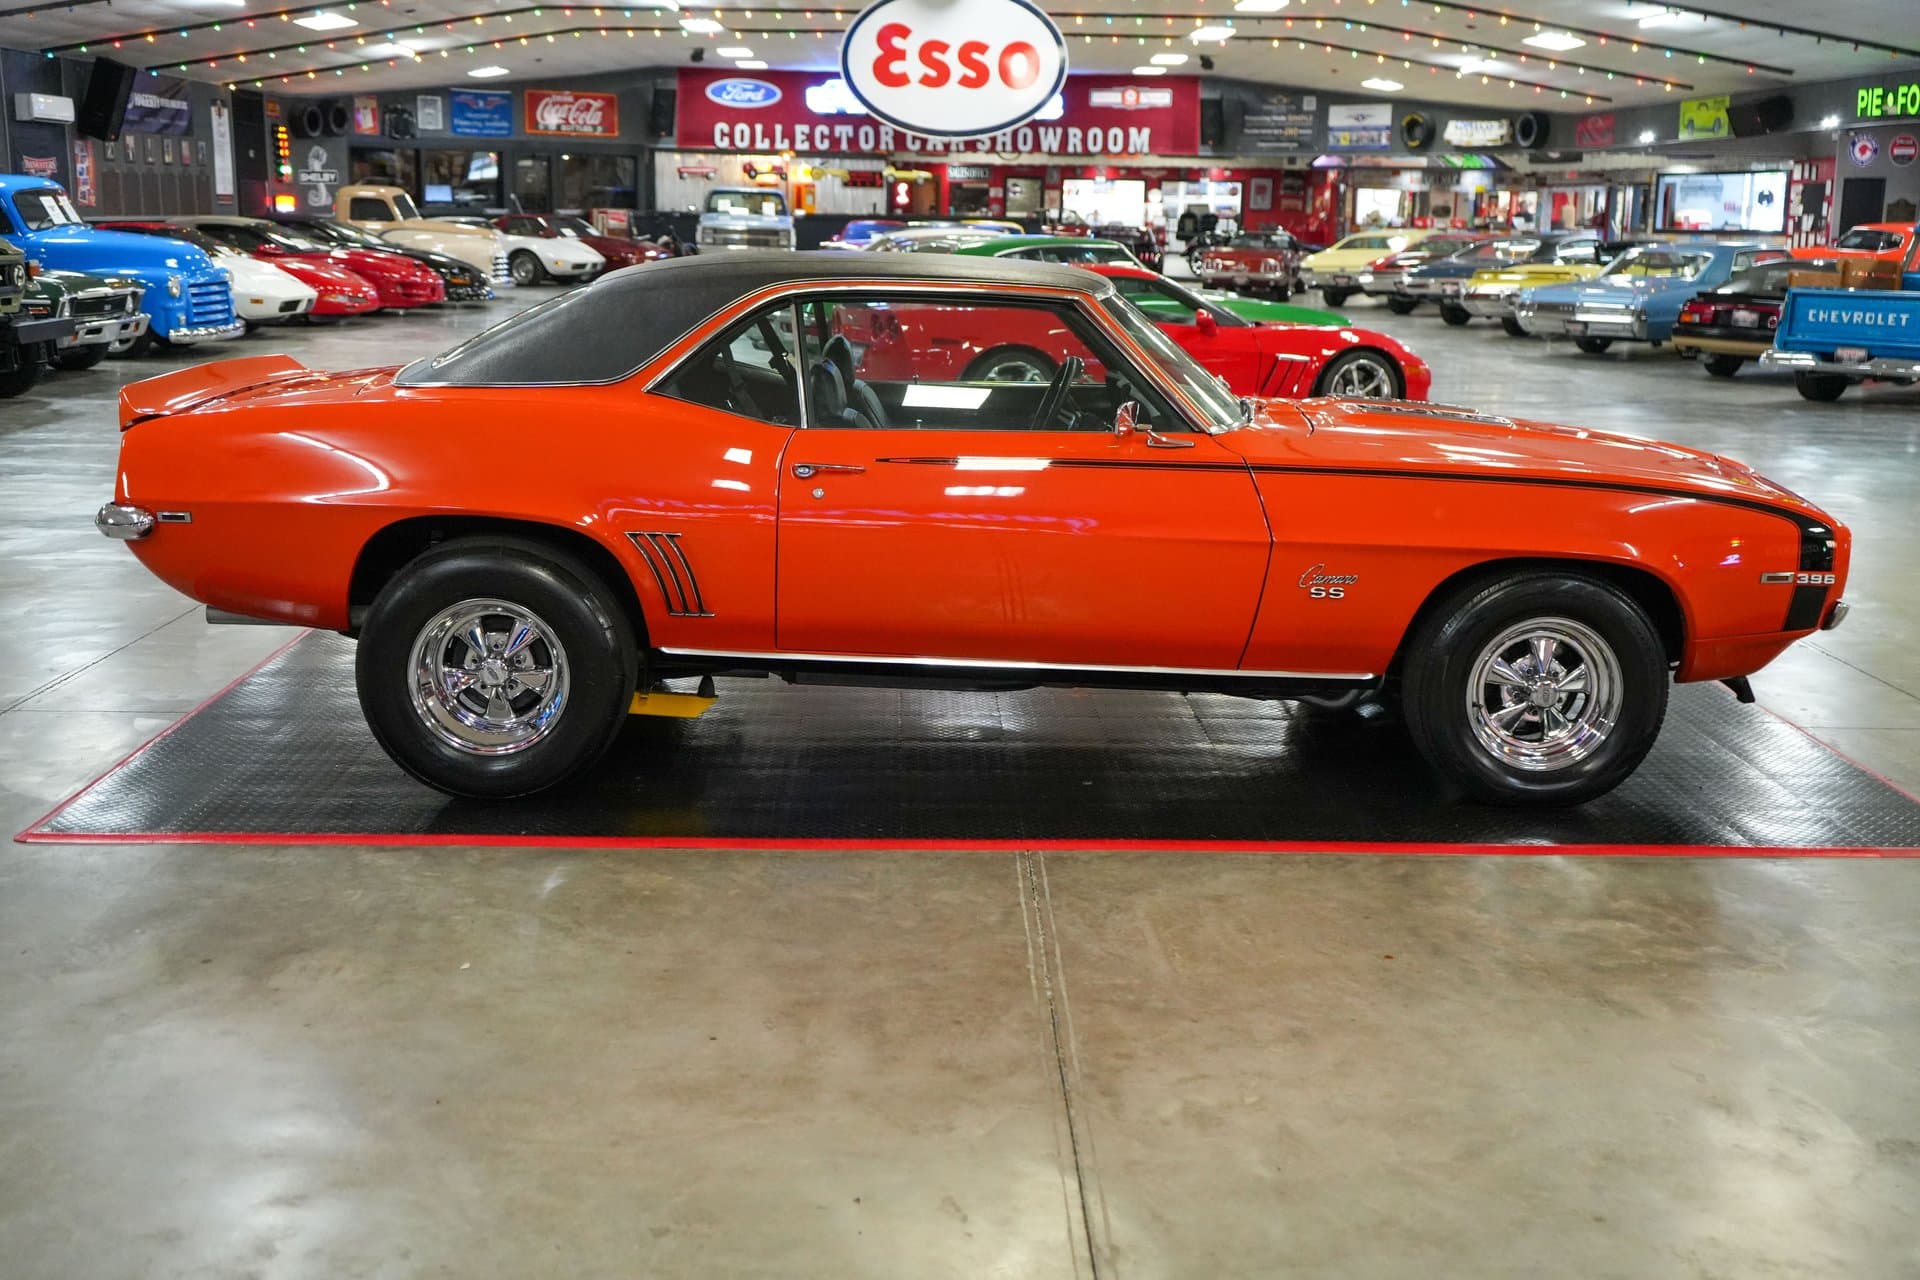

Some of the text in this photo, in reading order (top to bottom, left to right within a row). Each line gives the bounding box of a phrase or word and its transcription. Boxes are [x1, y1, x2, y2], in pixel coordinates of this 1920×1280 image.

[720, 83, 765, 101] Ford
[1857, 88, 1883, 117] PIE
[714, 122, 1150, 153] COLLECTOR CAR SHOWROOM
[1808, 309, 1910, 327] CHEVROLET
[1299, 563, 1358, 587] Camaro
[1797, 573, 1835, 584] 396
[1310, 586, 1345, 599] SS
